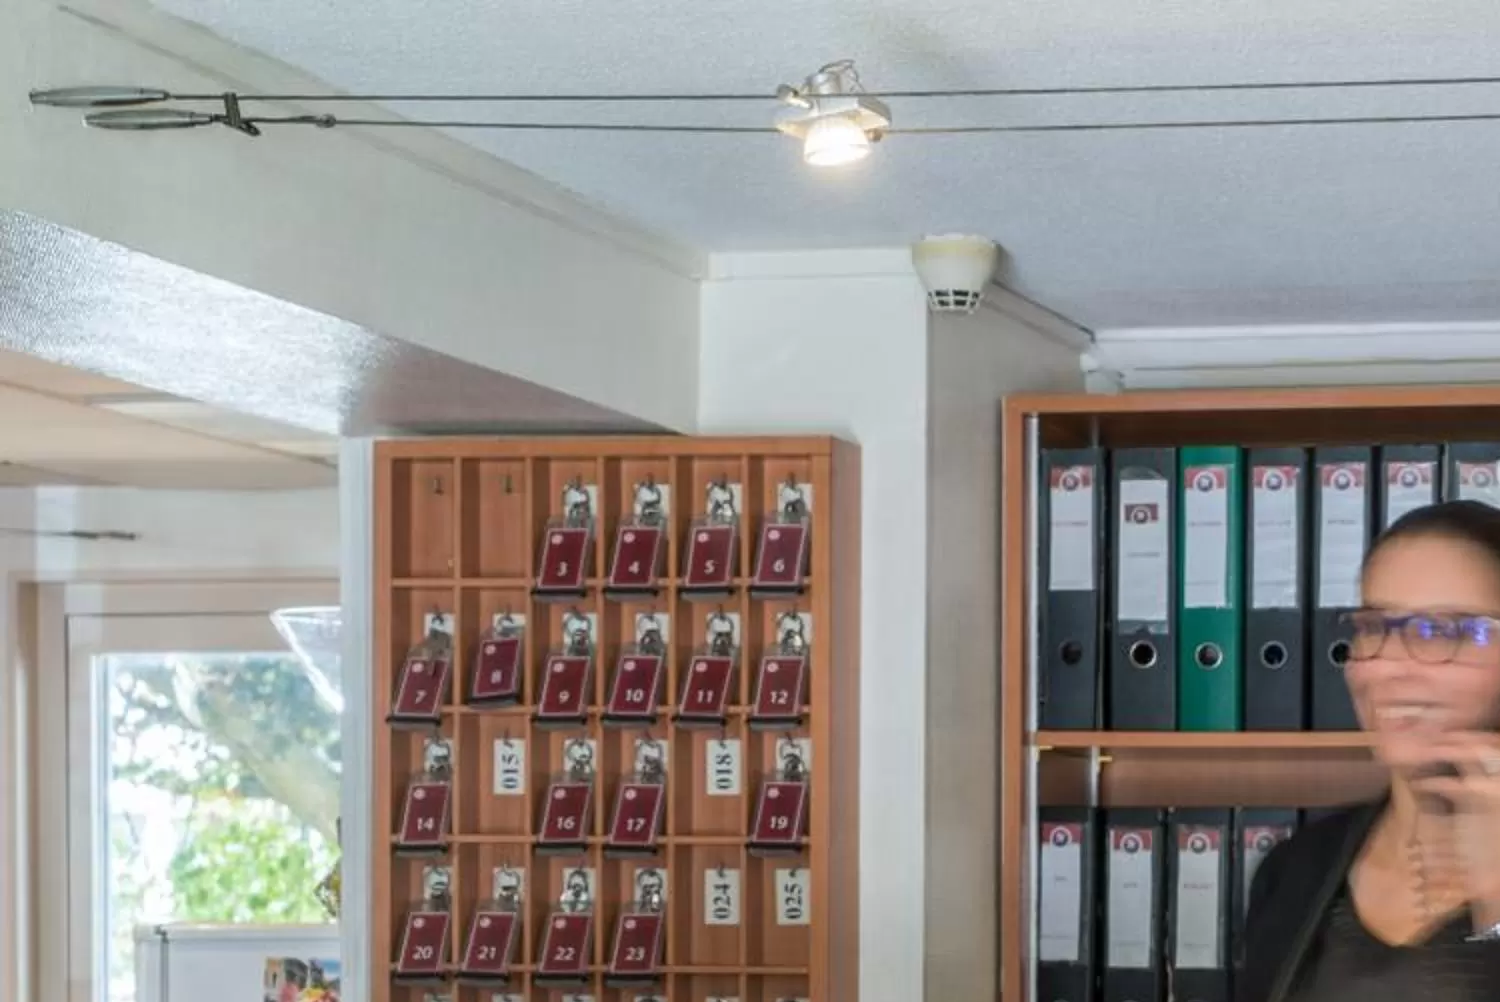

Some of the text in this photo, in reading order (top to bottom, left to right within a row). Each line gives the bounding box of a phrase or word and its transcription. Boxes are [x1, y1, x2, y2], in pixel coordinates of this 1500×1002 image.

[557, 562, 568, 577] 3
[629, 561, 640, 574] 4
[704, 560, 715, 574] 5
[774, 560, 785, 573] 6
[416, 690, 427, 704] 7
[559, 690, 570, 703] 9
[625, 689, 644, 702] 10
[696, 690, 714, 703] 11
[770, 690, 788, 704] 12
[502, 754, 519, 789] 015
[715, 753, 733, 789] 018
[417, 817, 434, 831] 14
[557, 816, 575, 830] 16
[626, 818, 645, 832] 17
[770, 816, 788, 830] 19
[714, 884, 731, 919] 024
[784, 883, 803, 919] 025
[412, 946, 433, 960] 20
[478, 947, 497, 960] 21
[554, 948, 575, 961] 22
[624, 947, 645, 961] 23
